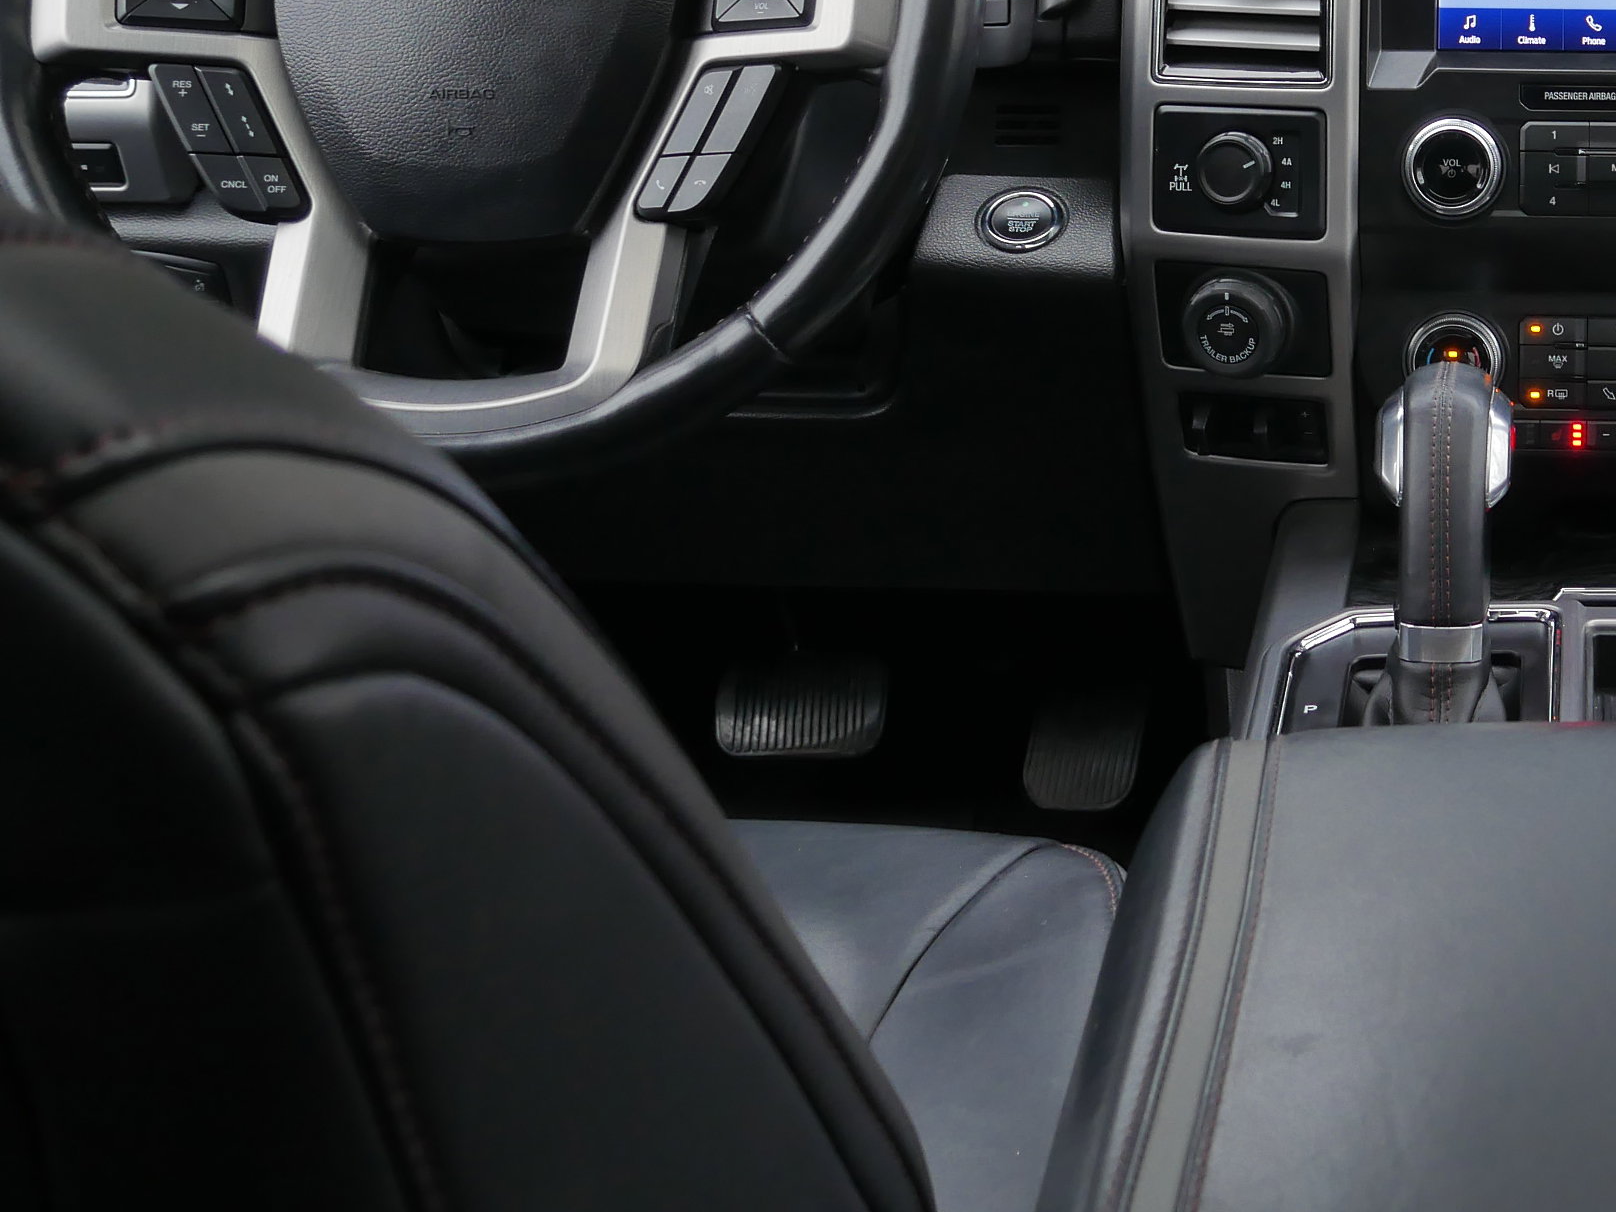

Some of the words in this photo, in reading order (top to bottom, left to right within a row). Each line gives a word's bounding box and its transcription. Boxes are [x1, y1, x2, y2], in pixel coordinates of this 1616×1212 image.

[754, 2, 769, 10] VOL
[1459, 35, 1481, 45] Audio
[1517, 35, 1547, 45] Climate
[1582, 36, 1606, 46] Phone
[429, 88, 497, 101] AIRBAG
[1544, 92, 1588, 101] PASSENGER
[1589, 92, 1616, 101] AIRBAG
[191, 123, 211, 131] SET
[1551, 130, 1557, 140] 1
[1273, 137, 1284, 145] 2H
[1282, 158, 1292, 166] 4A
[1442, 158, 1462, 168] VOL
[221, 180, 248, 189] CNCL
[267, 185, 287, 193] OFF
[1169, 182, 1193, 192] PULL
[1281, 181, 1292, 189] 4H
[1271, 199, 1281, 207] 4L
[1549, 196, 1557, 206] 4
[1200, 335, 1228, 363] TRAILER
[1229, 338, 1257, 364] BACKUP
[1548, 355, 1568, 363] MAX
[1304, 704, 1318, 713] P
